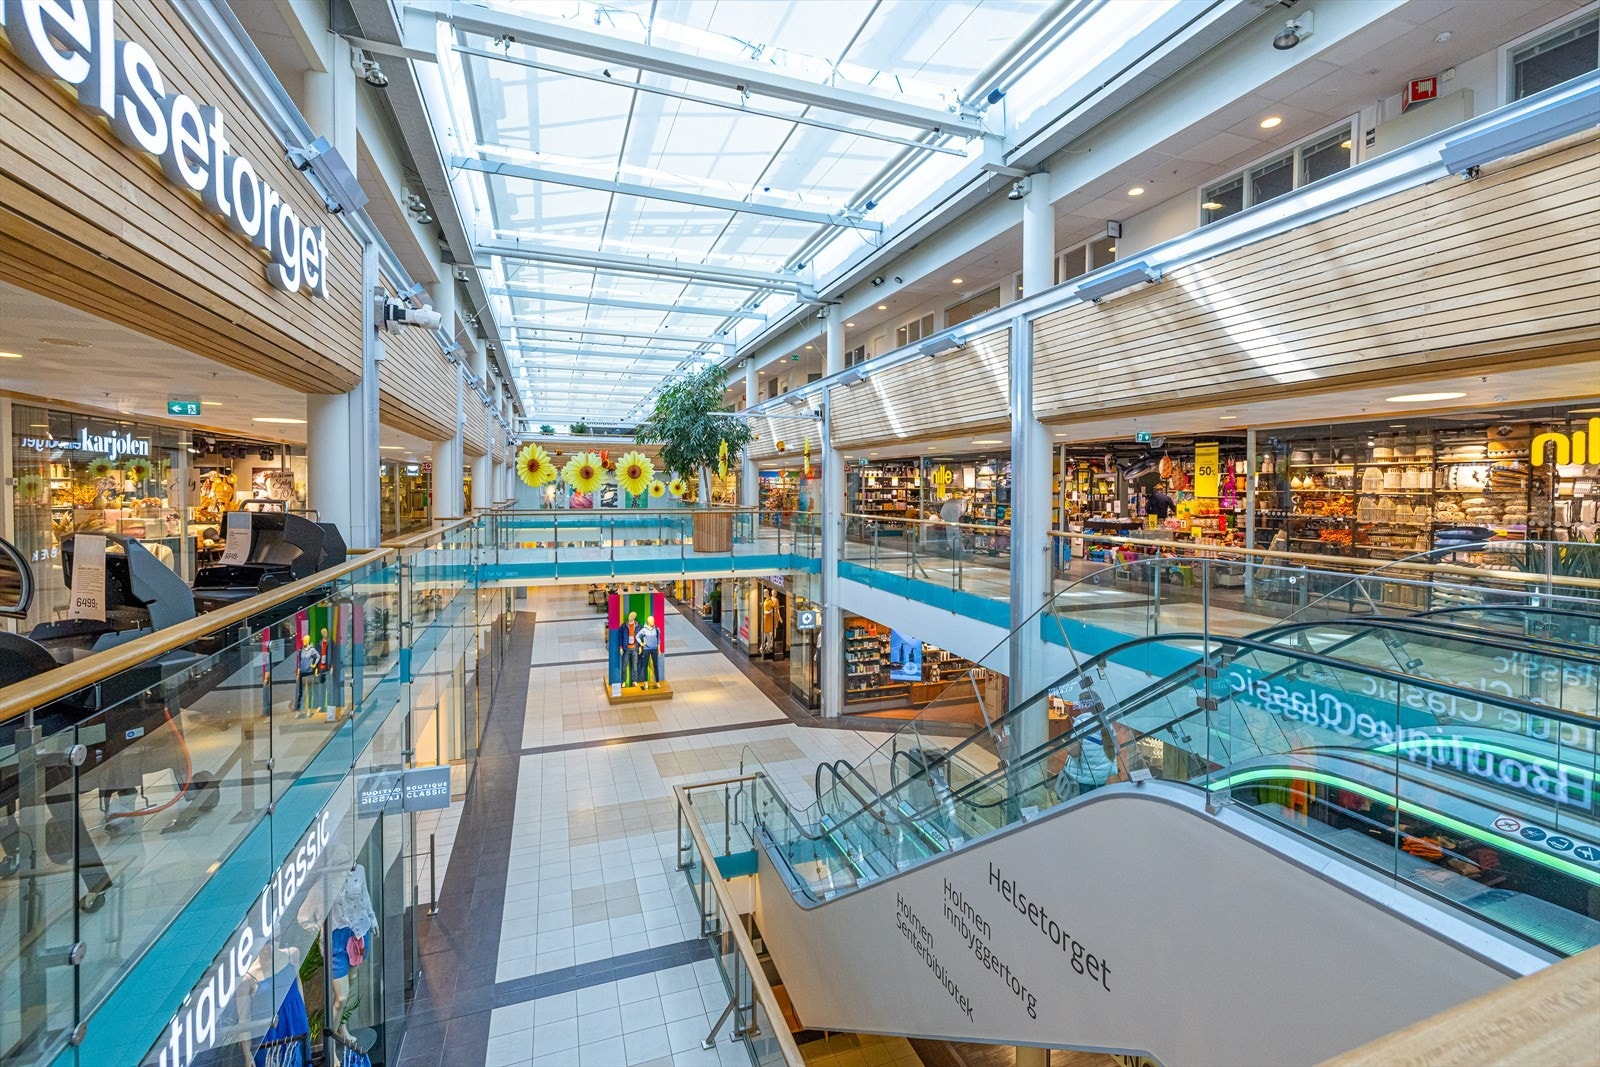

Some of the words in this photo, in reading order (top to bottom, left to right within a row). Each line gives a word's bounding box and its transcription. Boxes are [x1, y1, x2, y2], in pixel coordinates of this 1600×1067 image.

[0, 0, 329, 300] elsetorget
[81, 427, 149, 460] karjolen
[931, 464, 953, 485] nille
[406, 781, 448, 791] BOUTIQUE
[406, 788, 448, 799] CLASSIC
[261, 811, 331, 938] Classic
[896, 892, 934, 949] Holmen
[943, 878, 991, 941] Holmen
[989, 861, 1111, 992] Helsetorget
[896, 912, 974, 1022] Senterbibliotek
[943, 898, 1038, 1019] innbyggertorg
